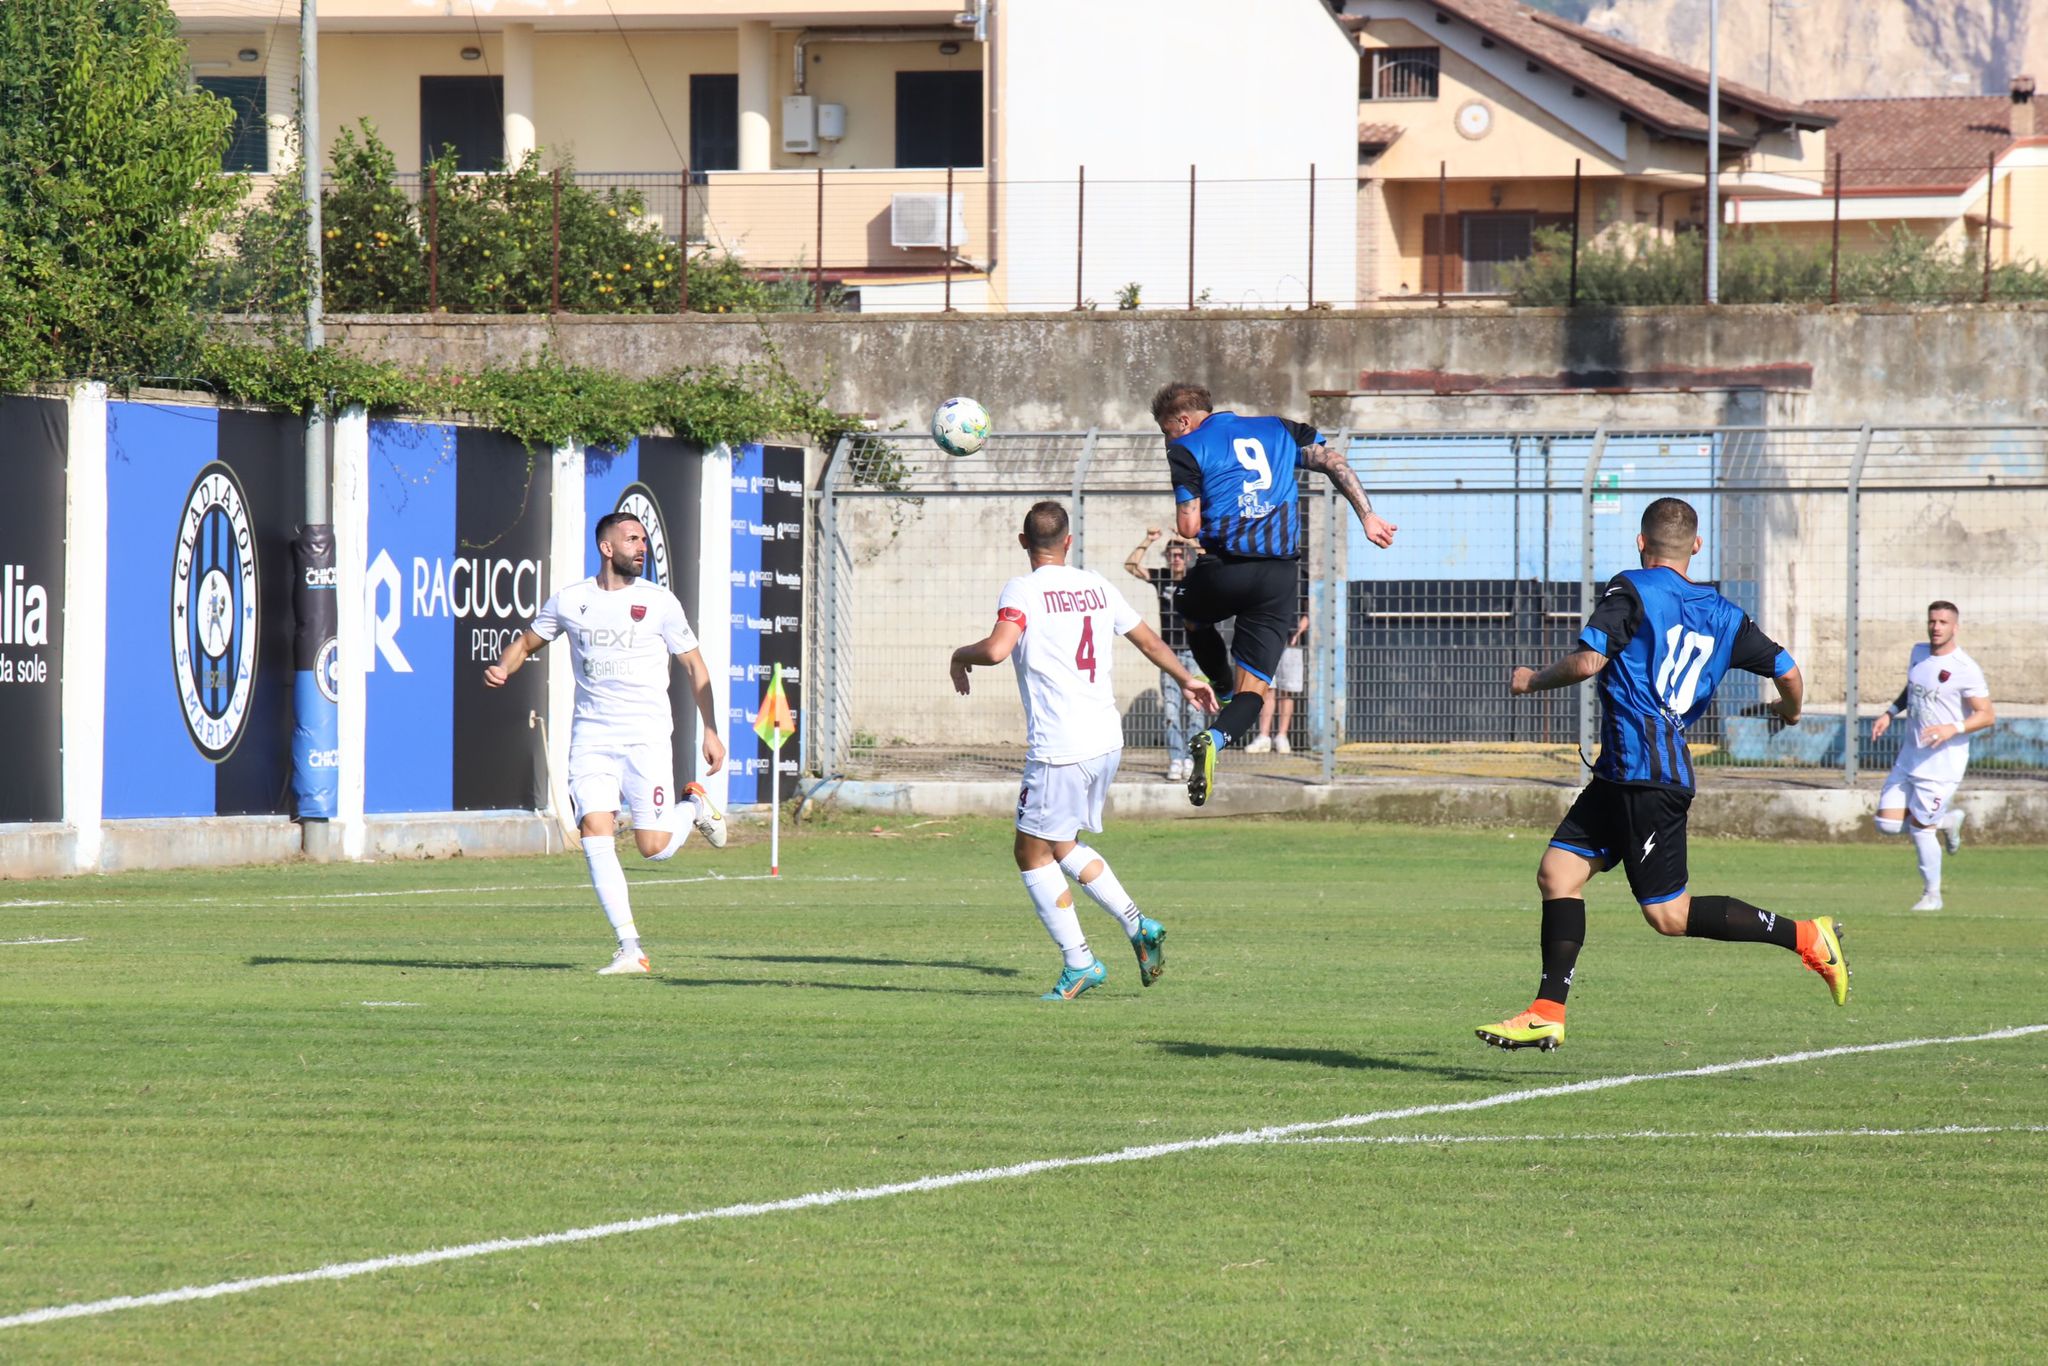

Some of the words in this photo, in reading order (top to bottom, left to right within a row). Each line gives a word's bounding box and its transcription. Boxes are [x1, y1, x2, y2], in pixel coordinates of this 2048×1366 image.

[1233, 437, 1272, 493] 9
[178, 476, 253, 582] GLADIATOR
[0, 565, 48, 646] lia
[412, 557, 542, 618] RAGUCCI
[1043, 586, 1107, 613] MENGOLI
[579, 624, 637, 648] next
[1075, 615, 1096, 683] 4
[17, 653, 47, 683] sole
[1655, 623, 1715, 715] 10
[186, 687, 233, 746] MARIA
[653, 785, 665, 807] 6
[1931, 797, 1942, 812] 5
